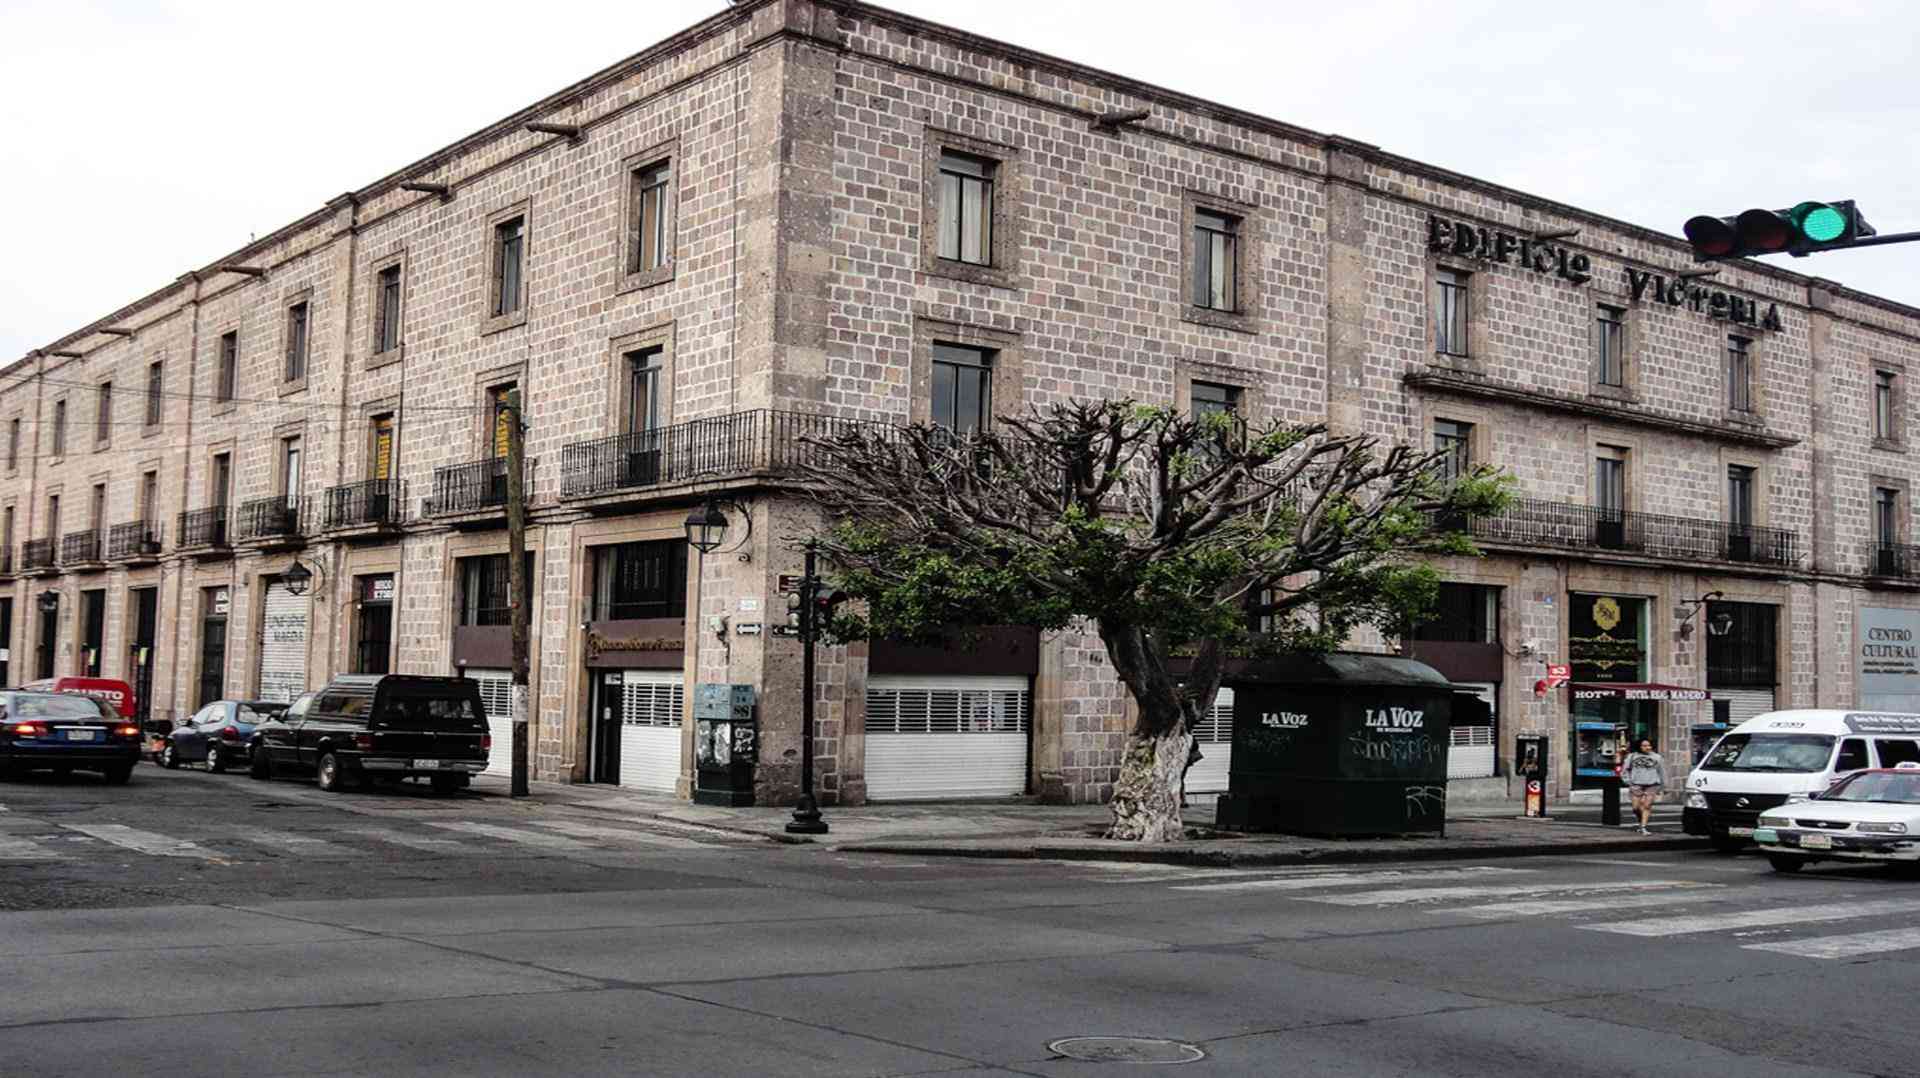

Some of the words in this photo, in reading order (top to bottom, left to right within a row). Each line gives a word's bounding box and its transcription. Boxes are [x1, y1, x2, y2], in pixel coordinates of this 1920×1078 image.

[1868, 627, 1912, 641] CENTRO
[1862, 644, 1919, 658] CULTURAL
[1262, 712, 1279, 725] LA
[1280, 711, 1308, 726] VOZ
[1365, 709, 1389, 727] LA
[1390, 706, 1424, 728] VOZ
